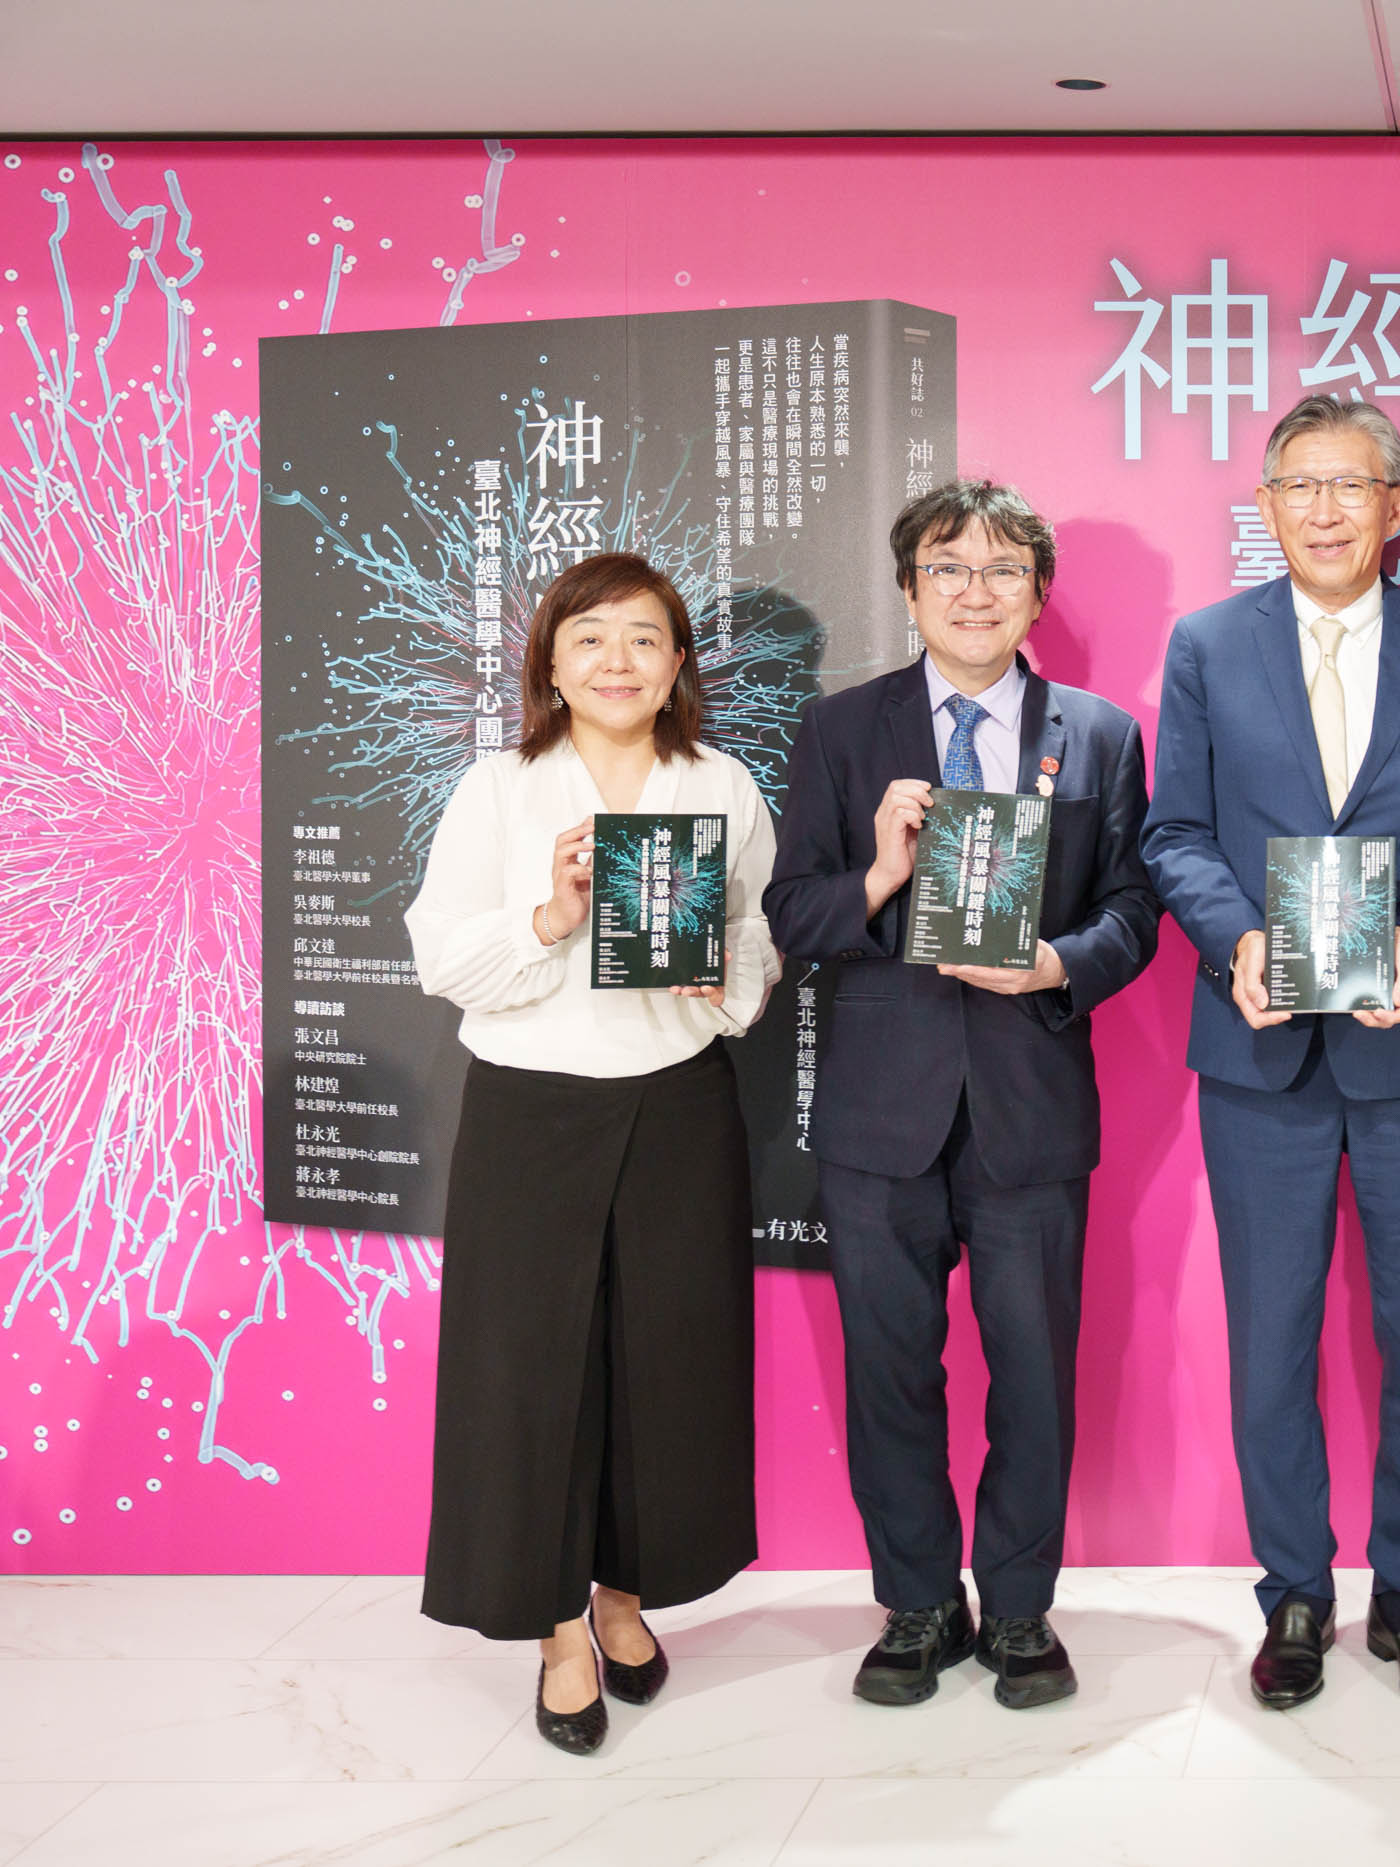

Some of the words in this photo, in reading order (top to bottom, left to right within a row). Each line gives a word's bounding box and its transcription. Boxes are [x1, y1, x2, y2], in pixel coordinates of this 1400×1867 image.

[910, 356, 925, 402] 共好誌
[833, 333, 850, 469] 當疾病突然來襲，
[809, 335, 826, 504] 人生原本熟悉的一切，
[910, 407, 924, 418] 02
[738, 339, 755, 547] 更是患者、家屬與醫療團隊
[761, 338, 779, 540] 這不只是醫療現場的挑戰，
[785, 336, 803, 540] 往往也會在瞬間全然改變。
[292, 825, 341, 840] 專文推薦
[293, 848, 336, 865] 李祖德
[292, 870, 371, 884] 臺北醫學大學董事
[962, 806, 995, 947] 神經風暴關鍵時刻
[293, 894, 335, 911] 吳麥斯
[650, 828, 672, 968] 神經風暴關鍵時刻
[292, 913, 372, 927] 臺北醫學大學校長
[293, 937, 336, 954] 邱文達
[293, 1000, 345, 1017] 導讀訪談
[294, 1027, 339, 1046] 張文昌
[294, 1050, 367, 1065] 中央研究院院士
[295, 1075, 340, 1094] 林建煌
[295, 1098, 399, 1117] 臺北醫學大學前任校長
[295, 1123, 340, 1143] 杜永光
[295, 1165, 340, 1185] 蔣永孝
[295, 1185, 399, 1206] 臺北神經醫學中心院長
